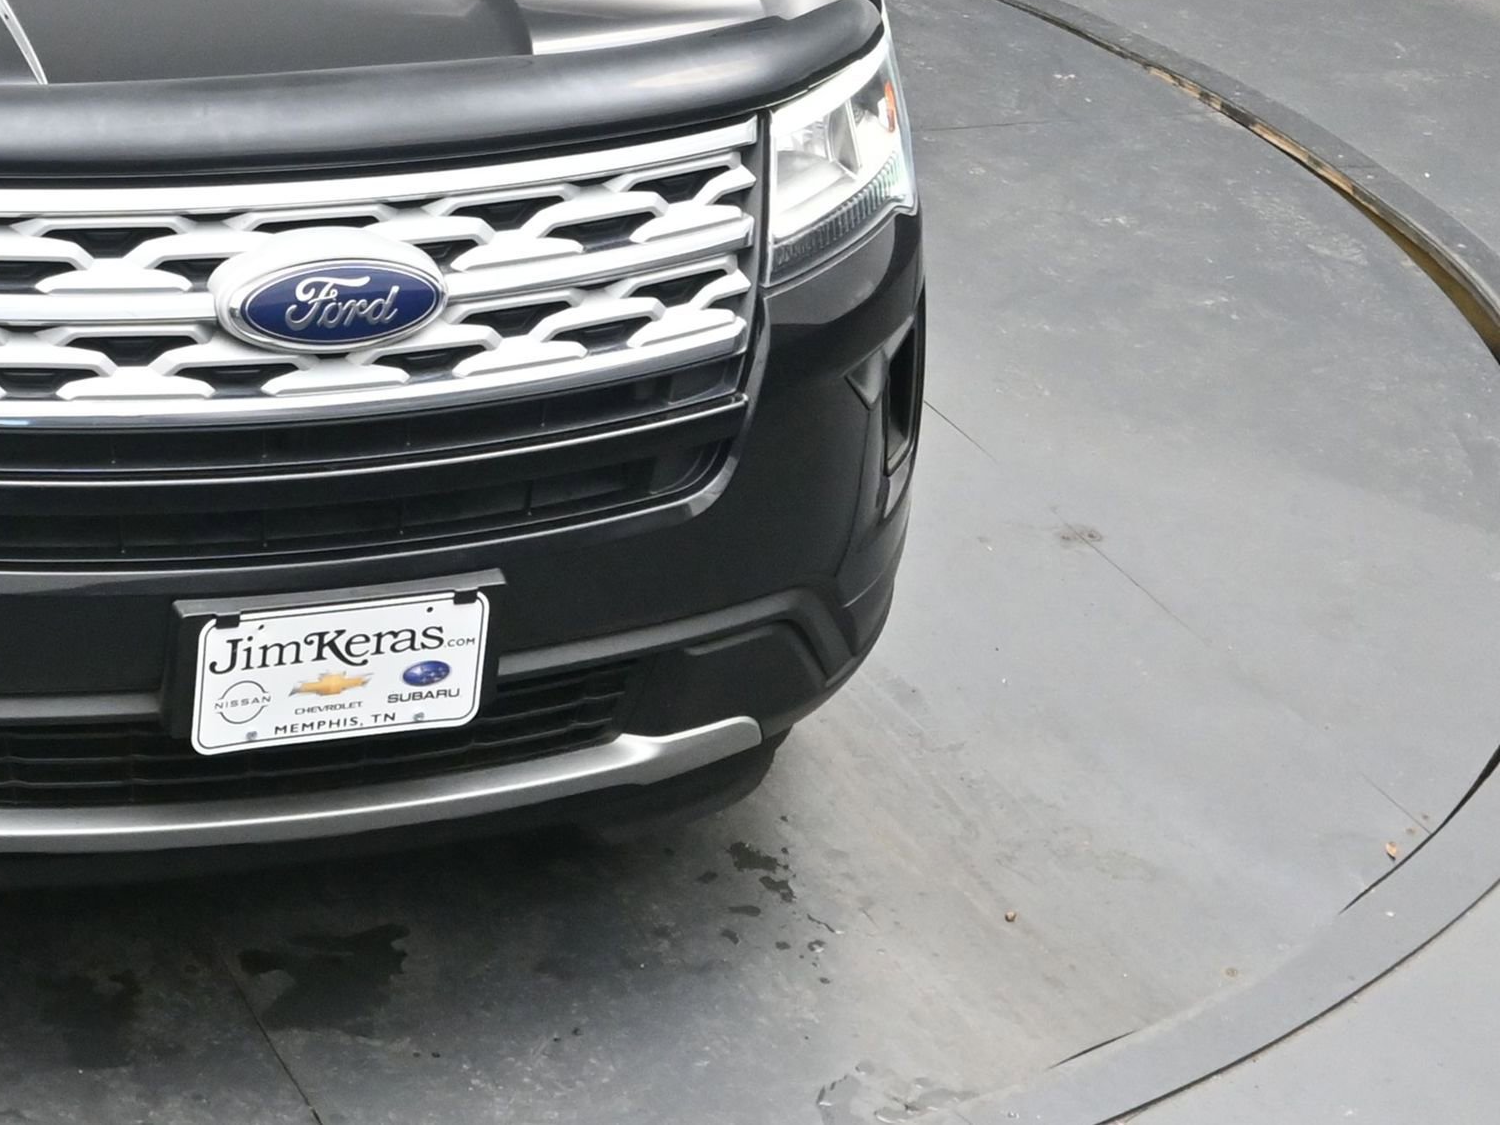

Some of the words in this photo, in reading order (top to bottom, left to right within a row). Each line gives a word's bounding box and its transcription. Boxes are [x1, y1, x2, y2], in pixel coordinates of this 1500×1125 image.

[285, 276, 399, 331] Ford
[214, 694, 272, 710] NISSAN
[387, 687, 461, 704] SUBARU
[294, 701, 363, 715] CHEVROLET
[274, 715, 364, 735] MEMPHIS,
[370, 711, 396, 724] TN
